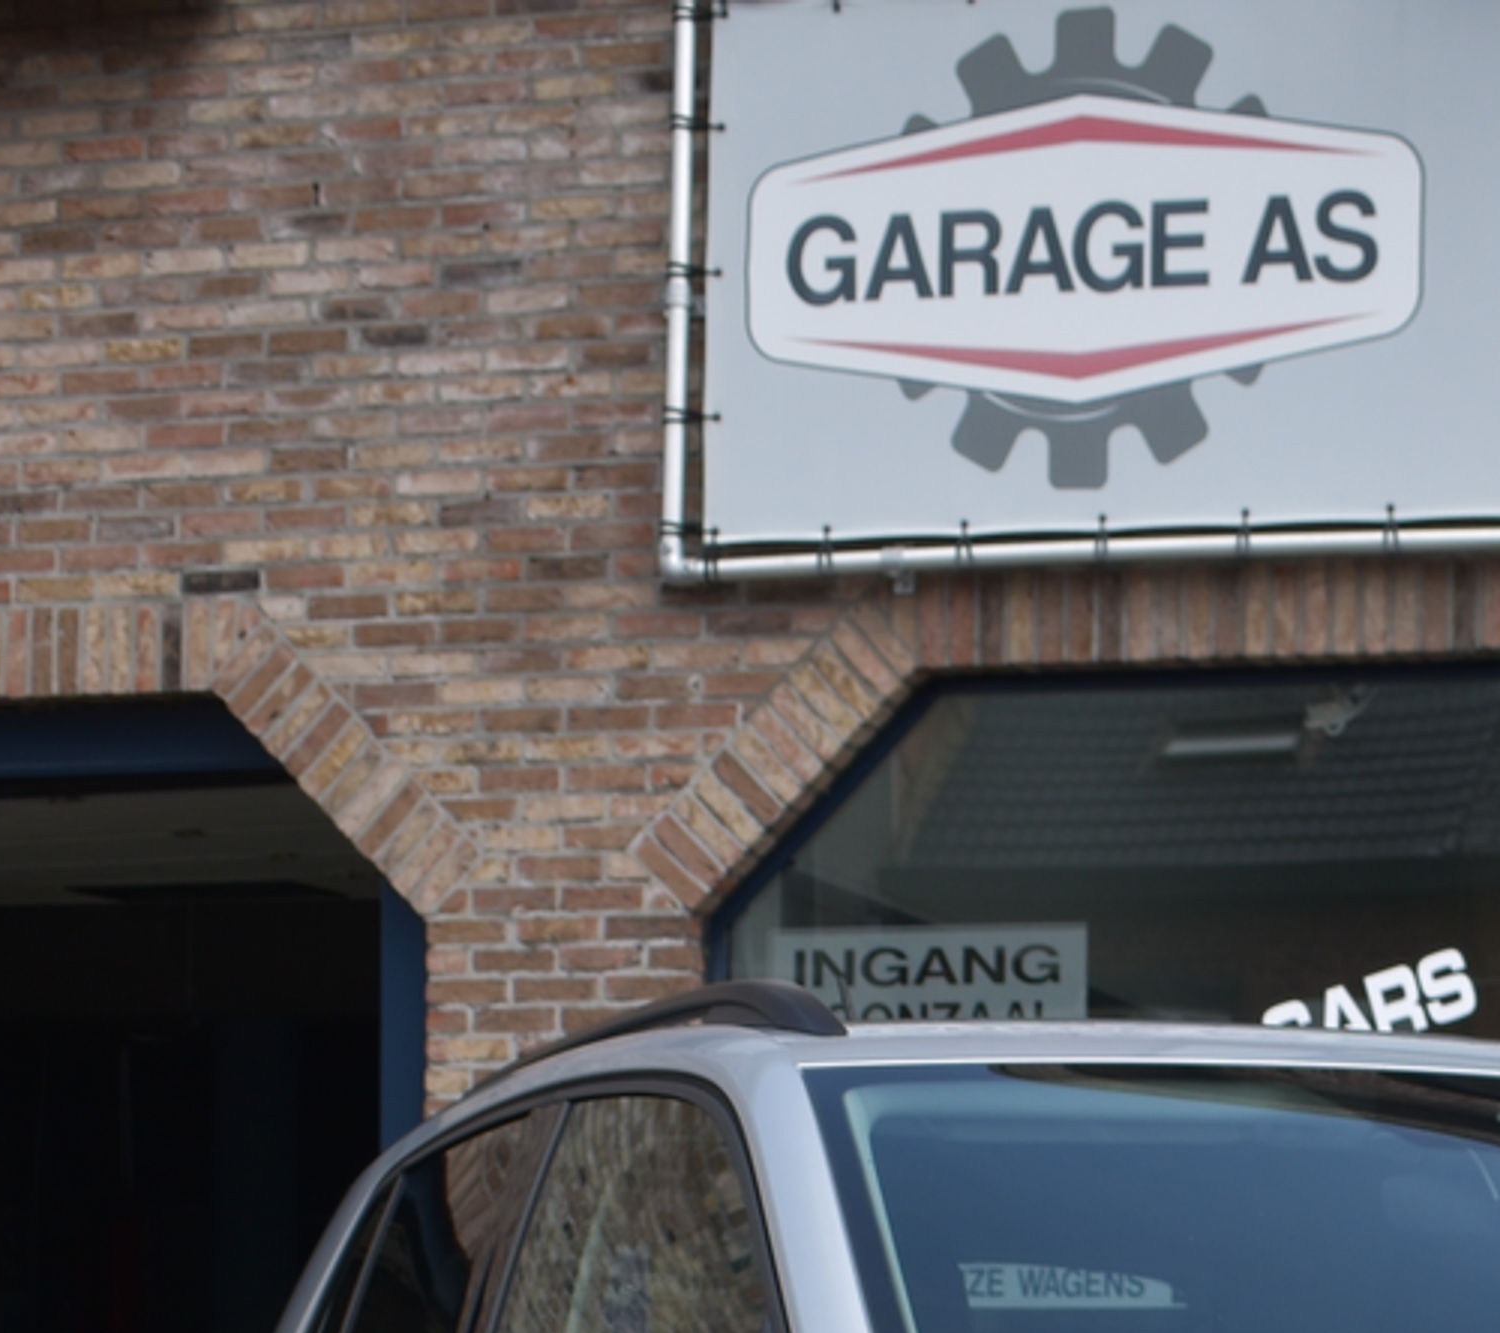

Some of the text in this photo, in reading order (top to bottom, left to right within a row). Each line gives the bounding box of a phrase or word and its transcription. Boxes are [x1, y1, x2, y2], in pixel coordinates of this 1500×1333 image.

[786, 189, 1380, 306] GARAGE AS
[793, 943, 1062, 988] INGANG
[1017, 1268, 1146, 1299] WAGENS
